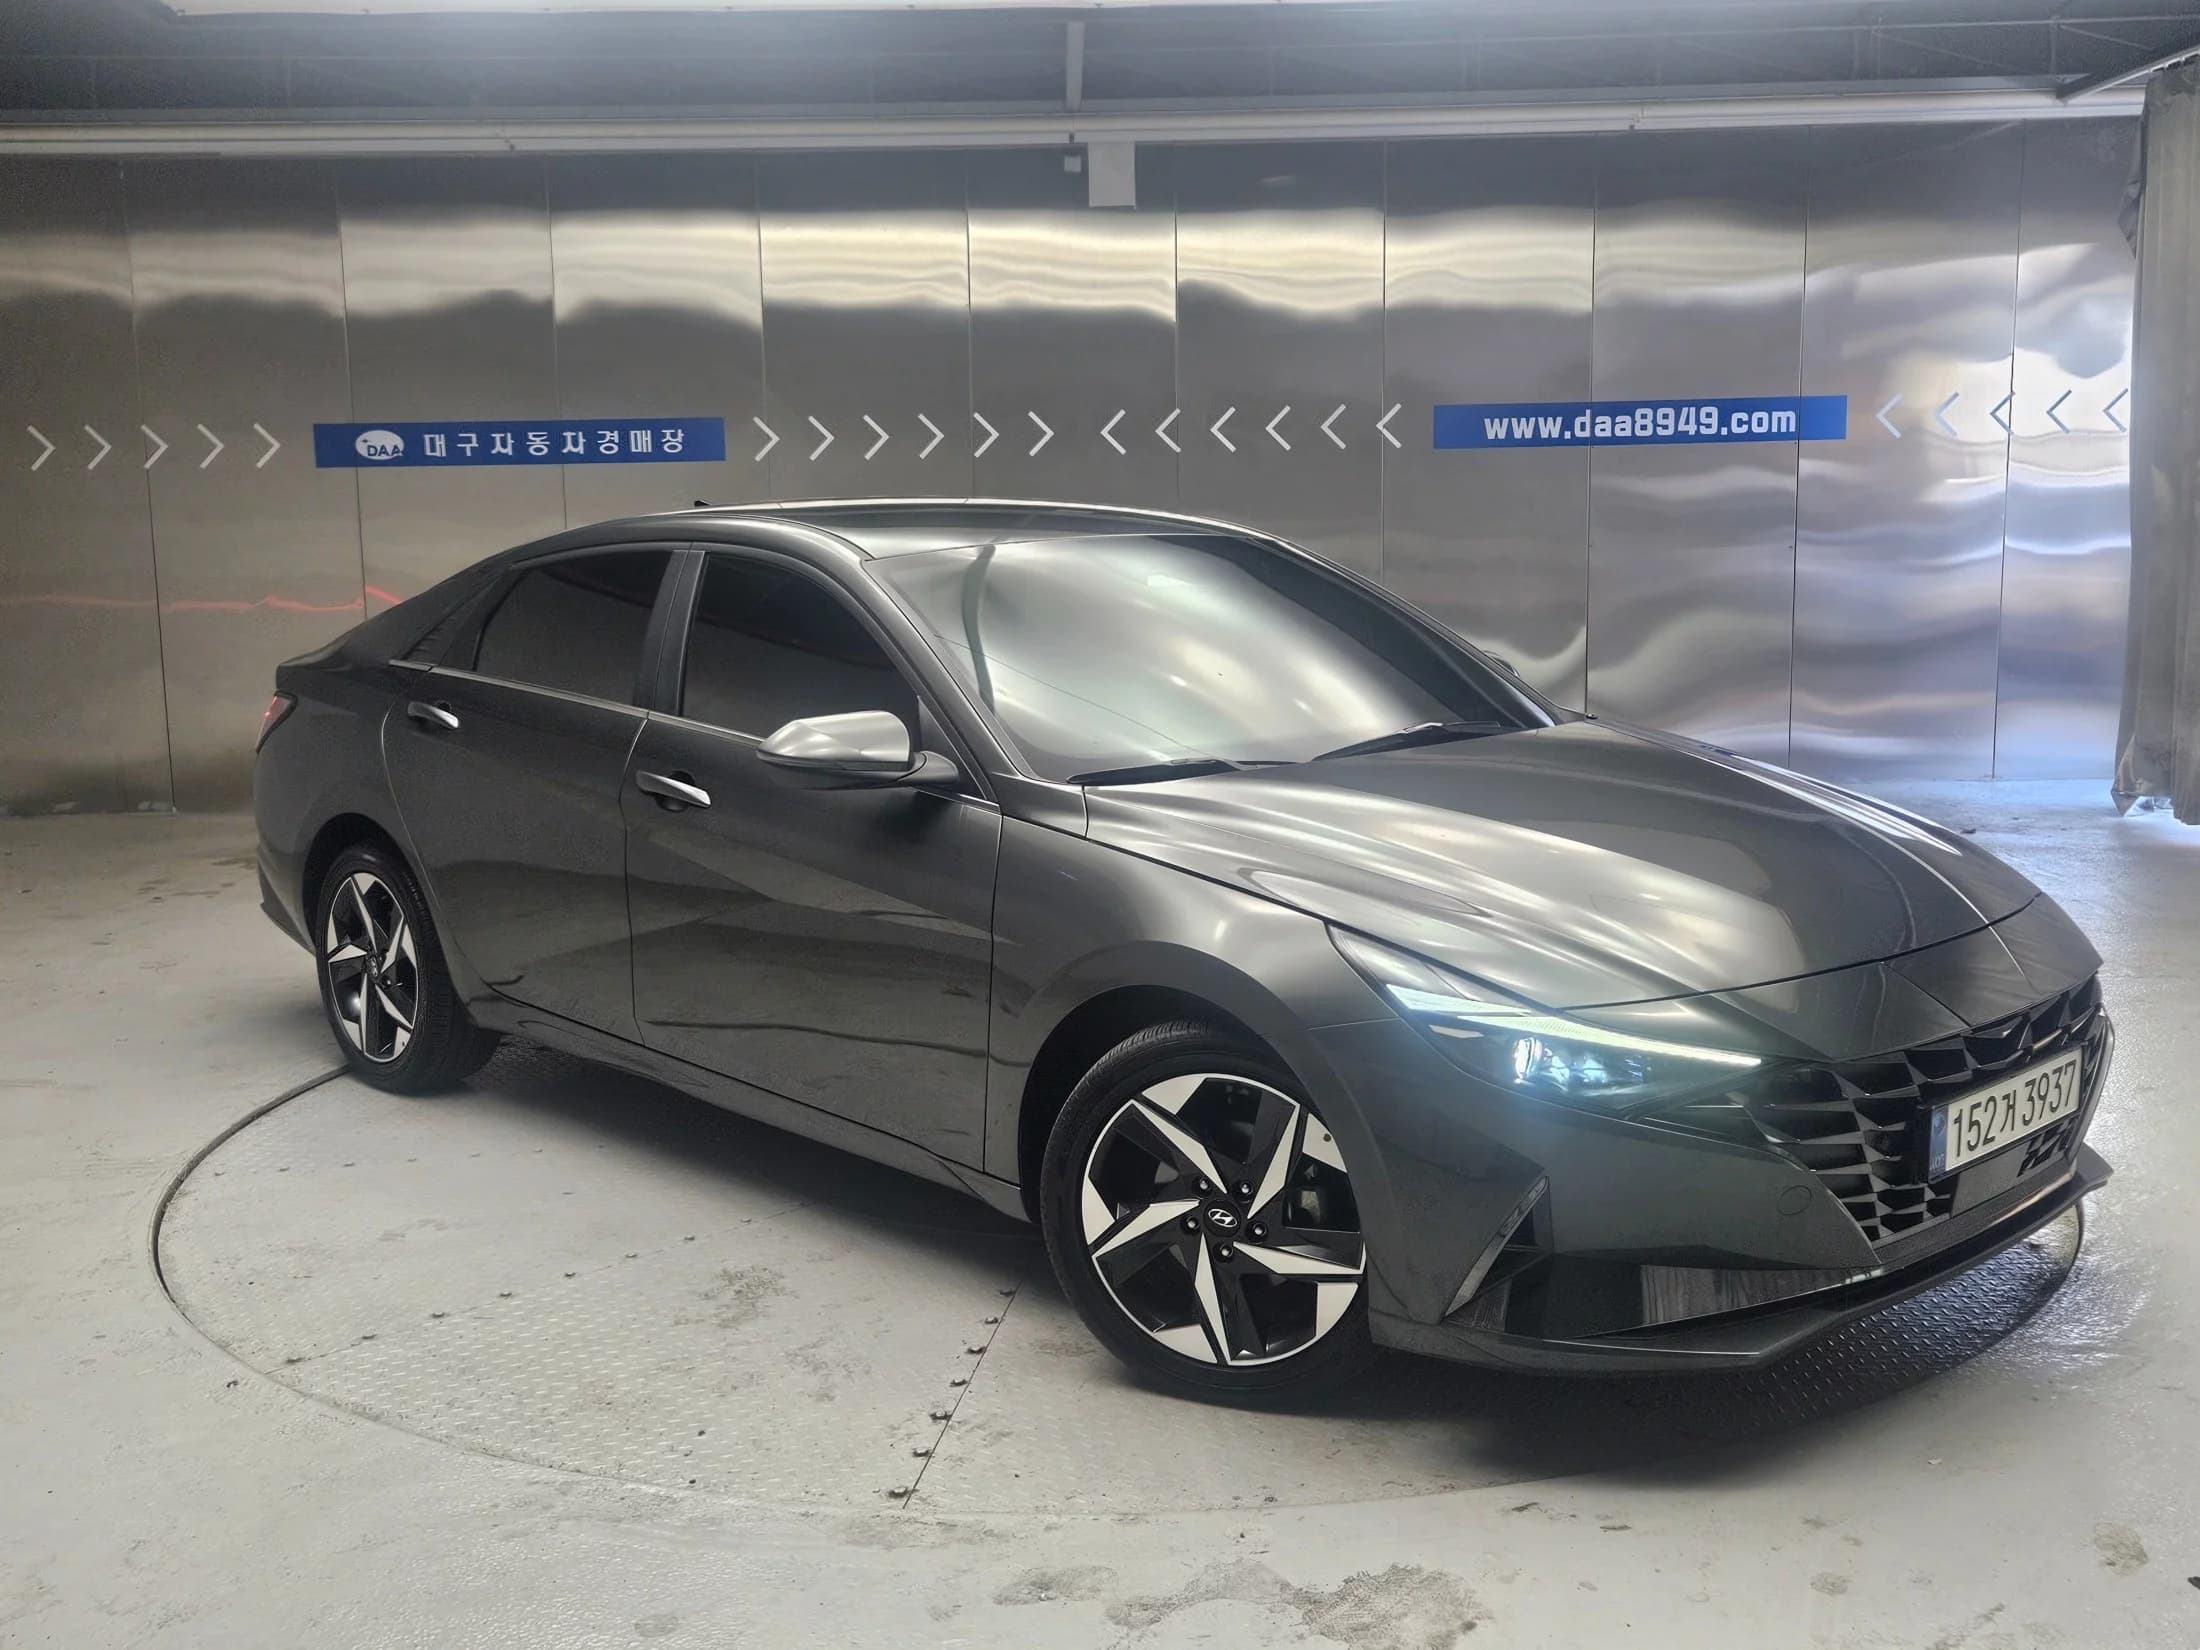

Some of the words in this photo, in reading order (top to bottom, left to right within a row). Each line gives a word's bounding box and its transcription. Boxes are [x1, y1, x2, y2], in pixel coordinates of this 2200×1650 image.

[1484, 406, 1797, 440] www.daa8949.com
[367, 444, 406, 457] DAA
[2022, 1059, 2077, 1127] 3937
